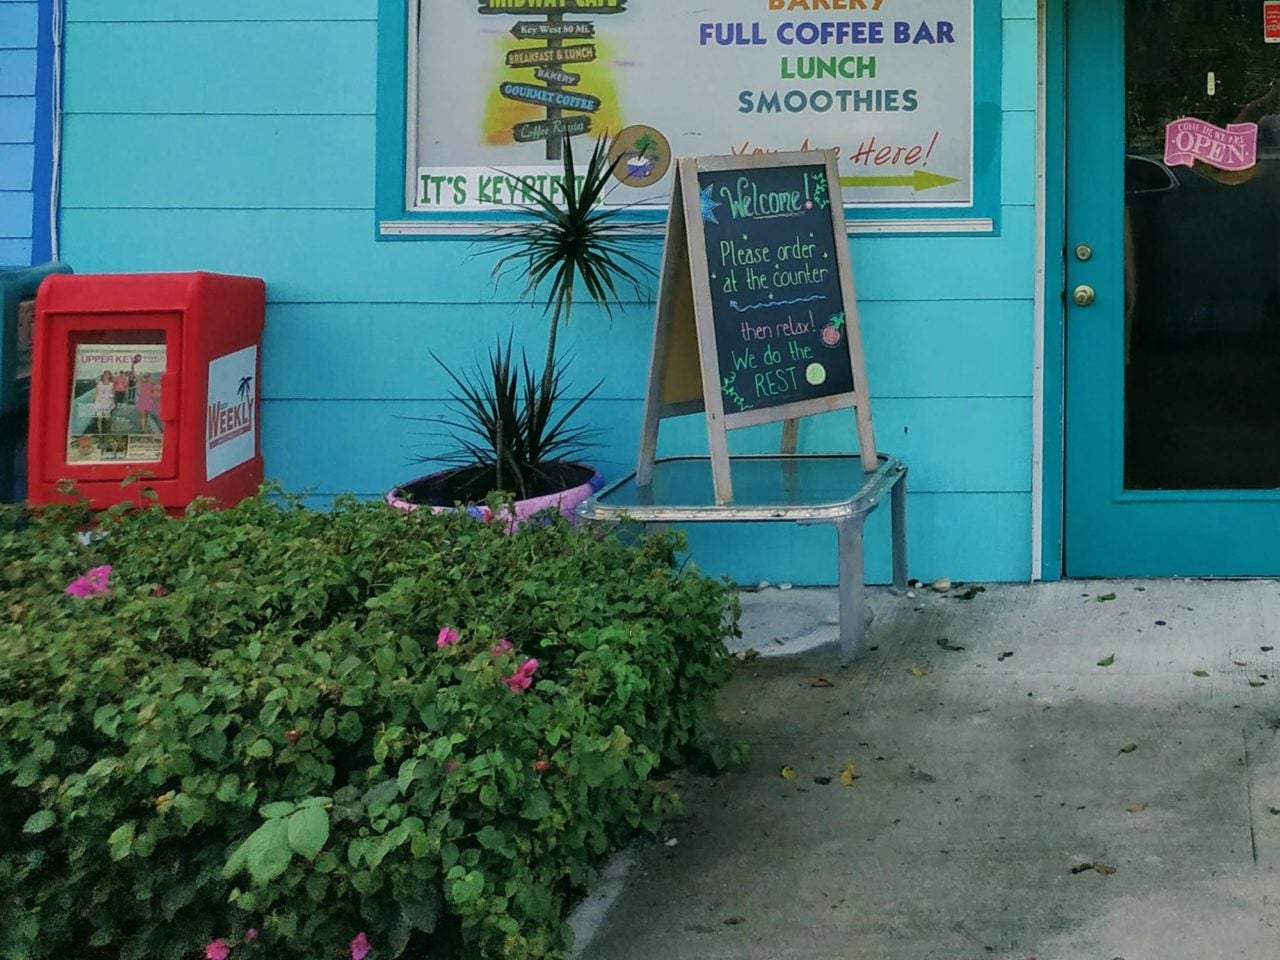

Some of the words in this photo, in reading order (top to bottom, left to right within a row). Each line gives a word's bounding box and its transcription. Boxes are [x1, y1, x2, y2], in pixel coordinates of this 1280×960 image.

[520, 25, 538, 36] Key
[539, 25, 562, 34] West
[563, 25, 574, 34] 80
[575, 25, 591, 34] Mi.
[700, 23, 767, 45] FULL
[777, 22, 884, 45] COFFEE
[894, 20, 955, 44] BAR
[508, 50, 553, 64] BREAKFAST
[564, 47, 593, 60] LUNCH
[781, 56, 876, 79] LUNCH
[537, 69, 575, 84] BAKERY
[504, 84, 554, 103] GOURMET
[556, 94, 594, 110] COFFEE
[738, 89, 918, 113] SMOOTHIES
[521, 123, 549, 140] Coffee
[850, 131, 939, 166] Here!
[1176, 131, 1247, 164] OPEN
[421, 175, 467, 205] IT'S
[720, 173, 813, 219] Welcome!
[720, 240, 770, 266] Please
[777, 236, 816, 262] order
[723, 273, 738, 293] at
[746, 268, 768, 290] the
[773, 266, 829, 288] counter
[740, 318, 773, 342] then
[776, 310, 816, 337] relax!
[81, 354, 113, 364] UPPER
[731, 347, 758, 372] We
[763, 344, 782, 364] do
[789, 341, 813, 360] the
[754, 366, 797, 398] REST
[208, 398, 254, 441] WEEKLY
